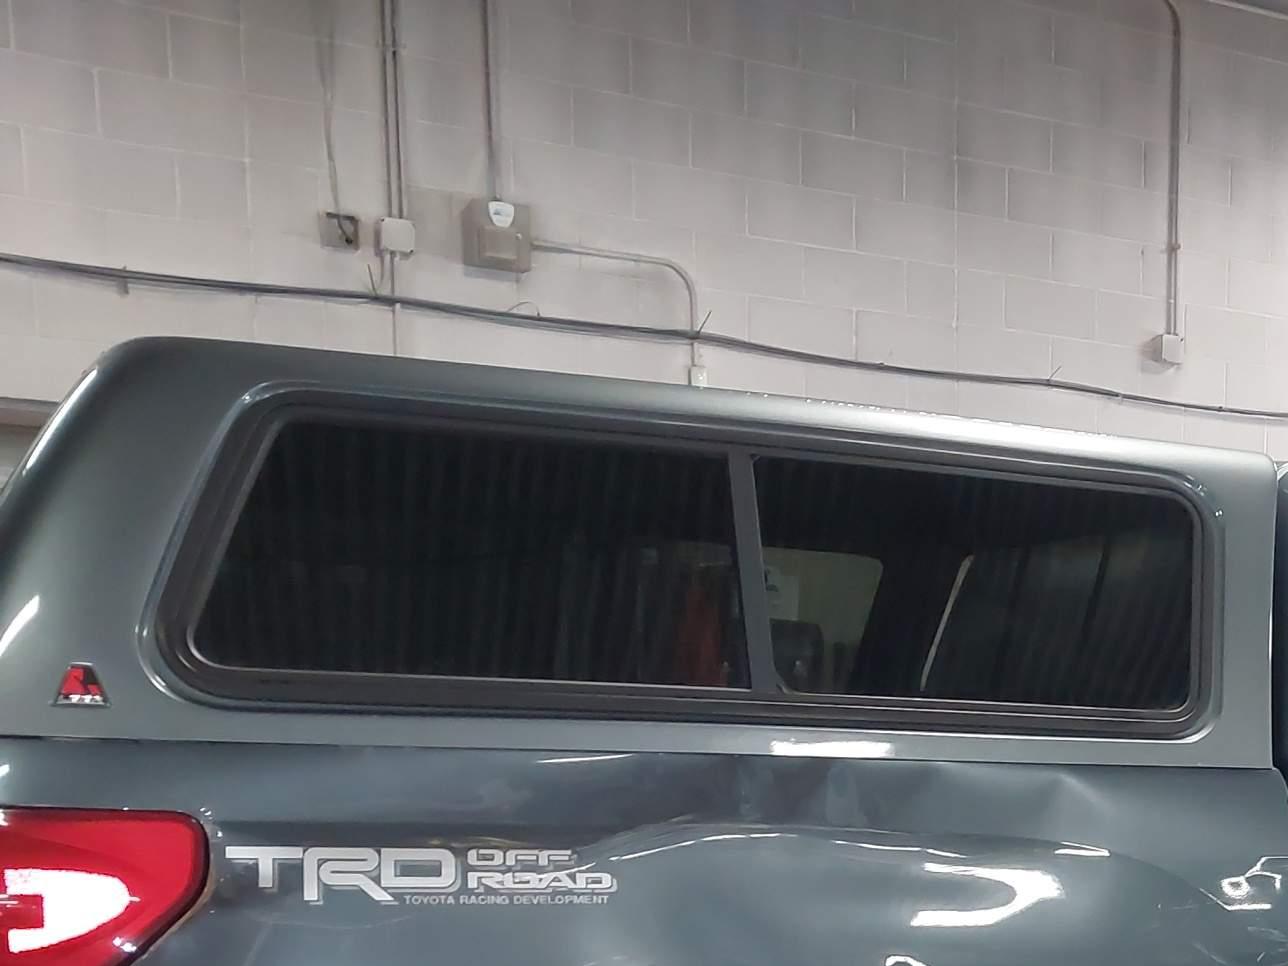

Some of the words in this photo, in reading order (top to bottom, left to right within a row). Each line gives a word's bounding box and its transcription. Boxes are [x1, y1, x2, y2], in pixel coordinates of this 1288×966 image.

[466, 848, 575, 868] OFF
[225, 846, 460, 905] TRD
[466, 871, 617, 892] ROAD
[403, 895, 455, 905] TOYOTA
[459, 895, 510, 905] RACING
[513, 895, 609, 905] DEVELOPMENT
